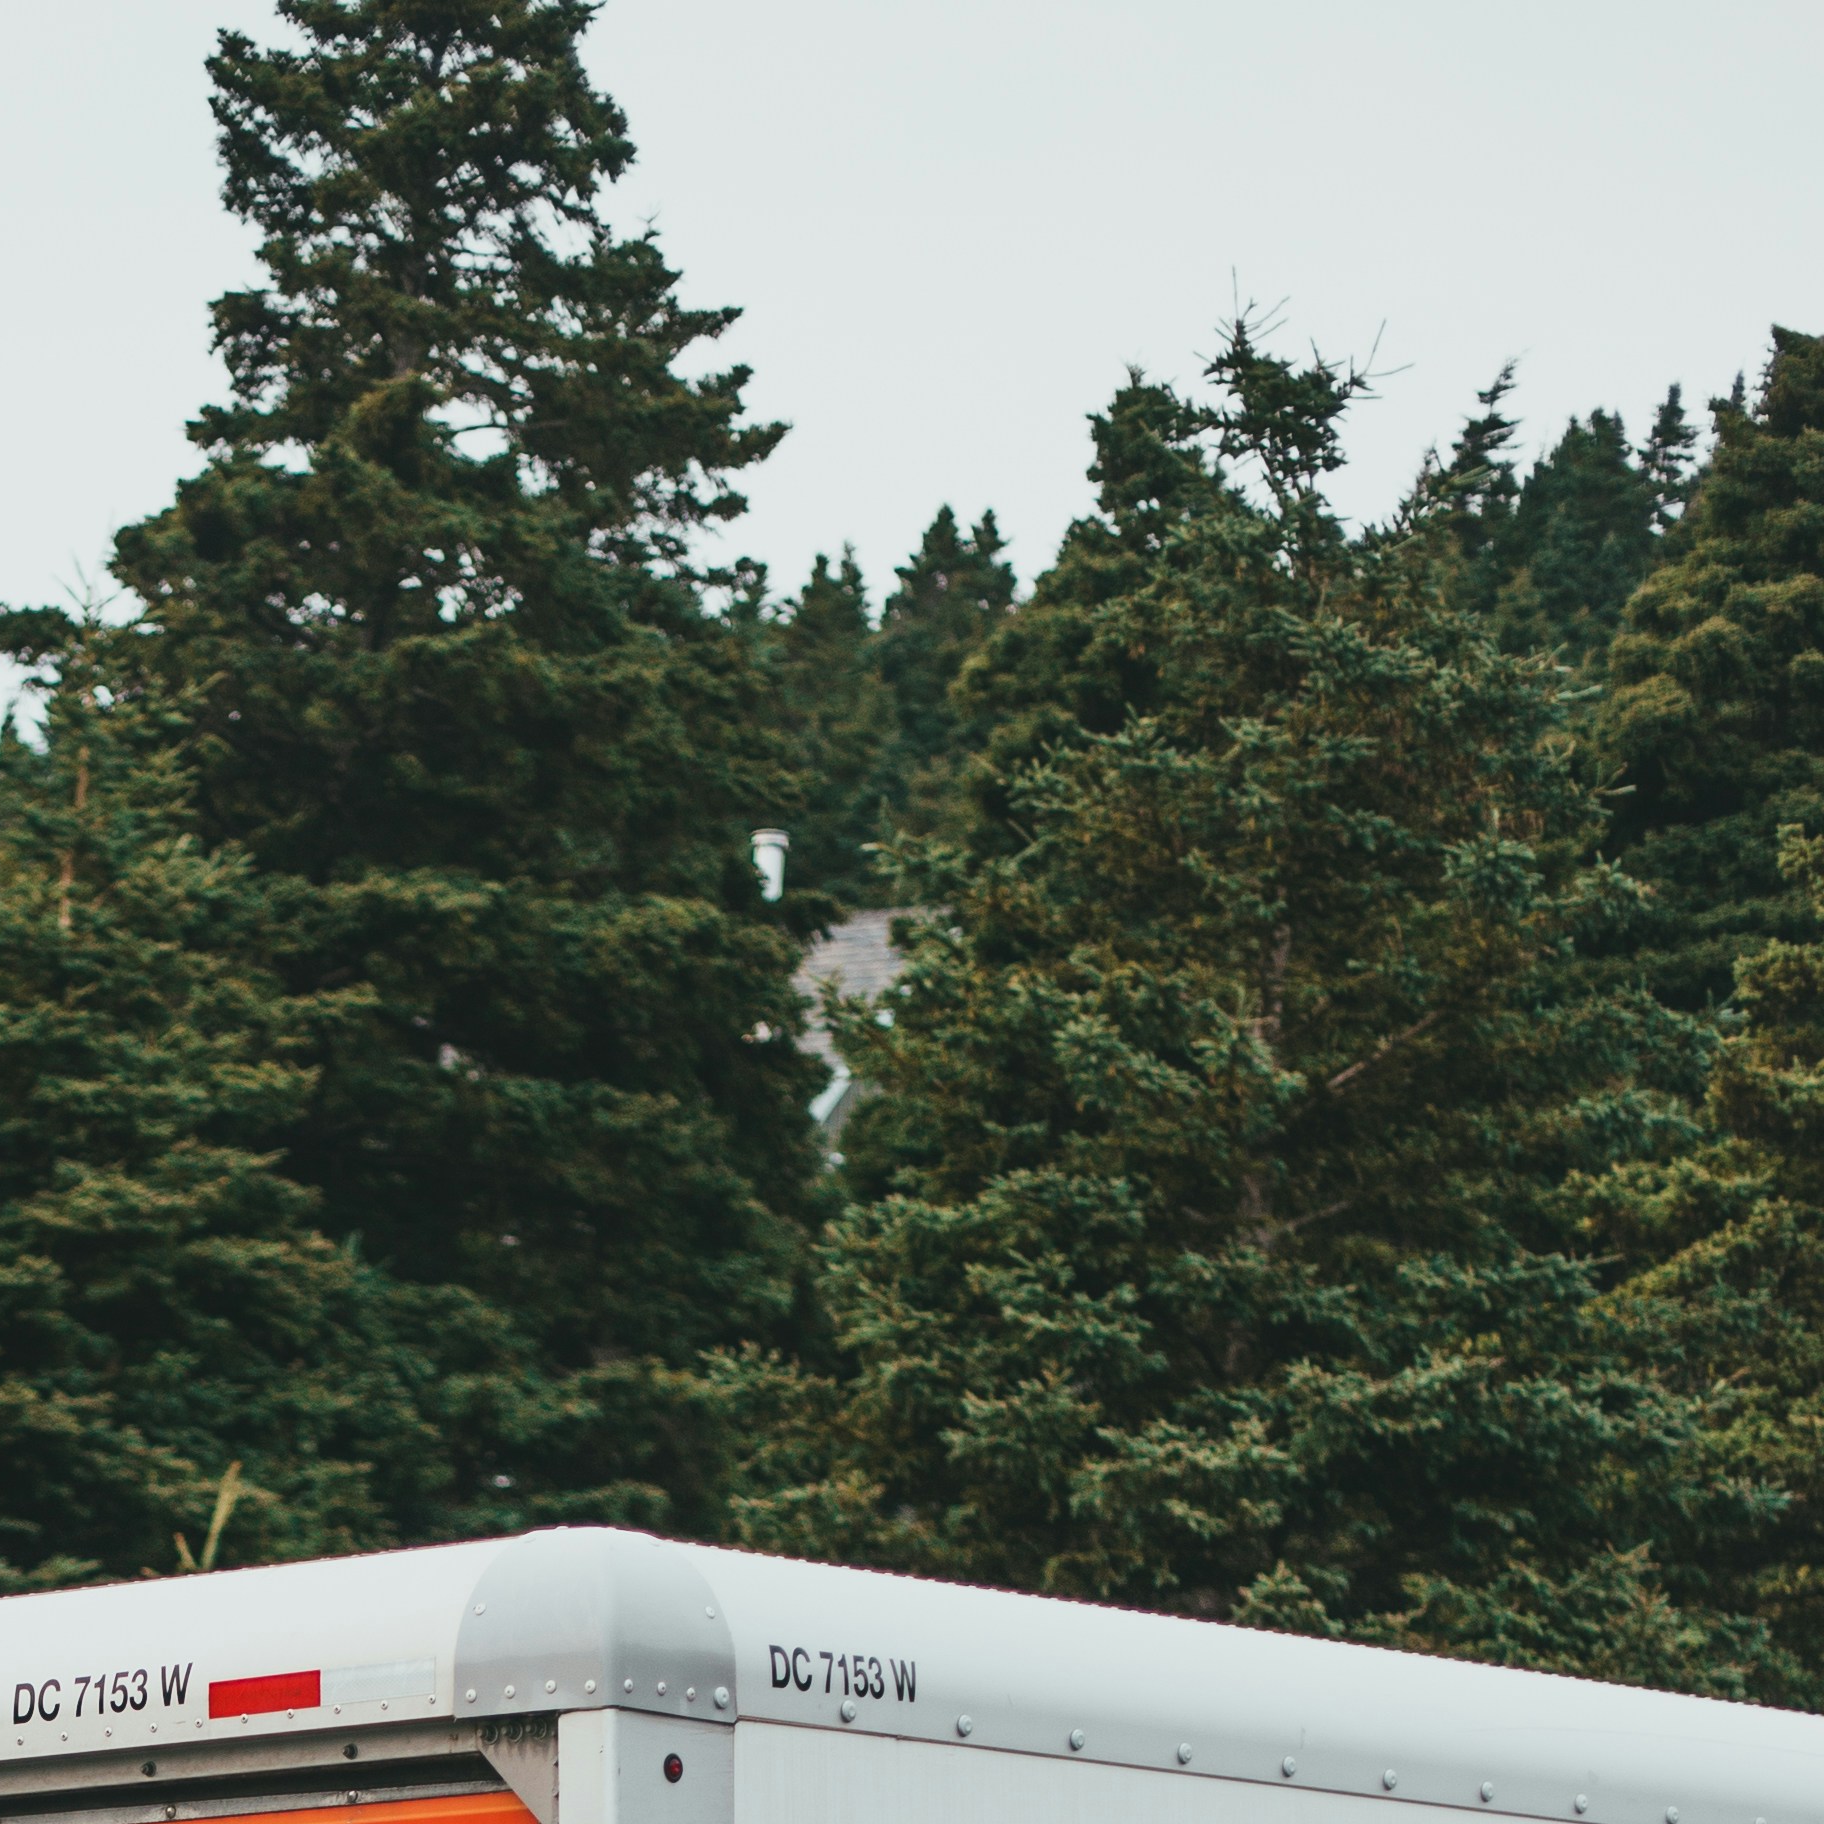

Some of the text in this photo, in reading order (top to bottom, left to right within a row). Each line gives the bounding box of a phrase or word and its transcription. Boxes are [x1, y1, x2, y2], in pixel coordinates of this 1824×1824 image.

[13, 1662, 193, 1724] DC 7153 W
[768, 1644, 916, 1702] DC 7153 W
